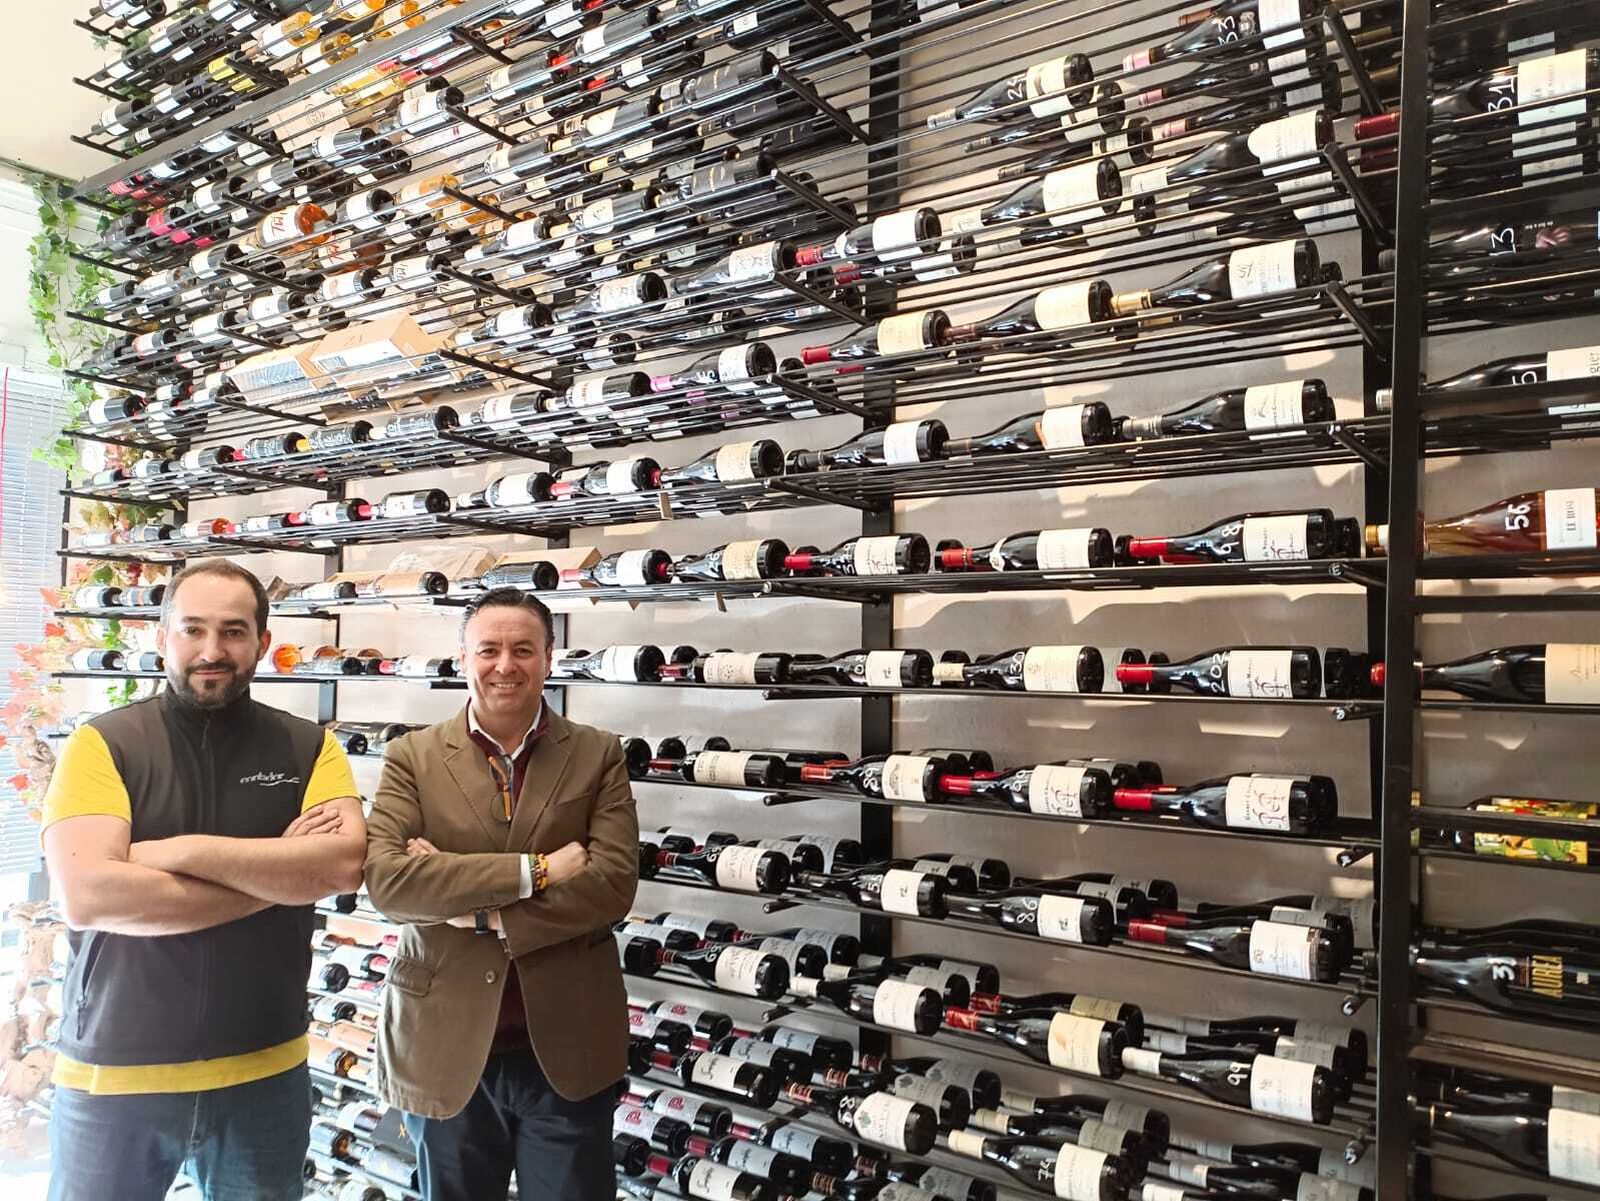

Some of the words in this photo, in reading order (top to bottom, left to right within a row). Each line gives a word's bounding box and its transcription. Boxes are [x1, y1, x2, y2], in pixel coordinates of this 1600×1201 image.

[1505, 504, 1532, 531] 56
[1008, 652, 1025, 683] 130
[1210, 652, 1232, 695] 202
[1016, 898, 1038, 924] 86
[1532, 954, 1563, 998] AUREA
[1227, 1061, 1251, 1086] 99
